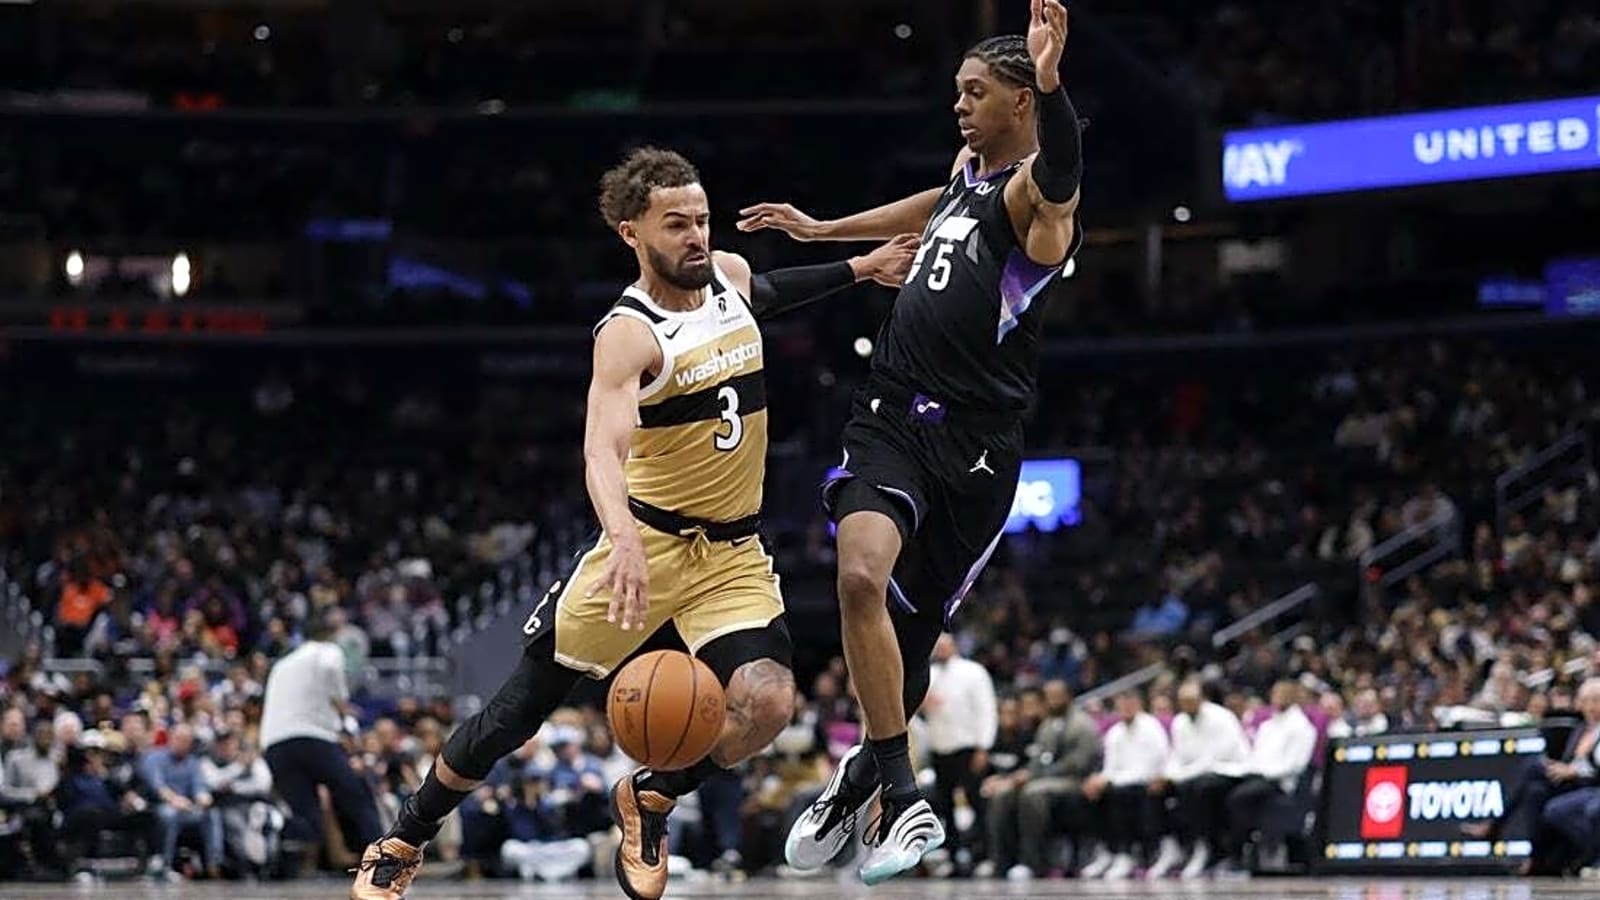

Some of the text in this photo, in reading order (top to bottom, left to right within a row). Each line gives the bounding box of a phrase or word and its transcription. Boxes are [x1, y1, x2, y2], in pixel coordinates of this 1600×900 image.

[1413, 118, 1589, 164] UNITED
[927, 242, 954, 291] 5
[675, 341, 761, 387] washington
[714, 386, 742, 451] 3
[1408, 780, 1504, 820] TOYOTA
